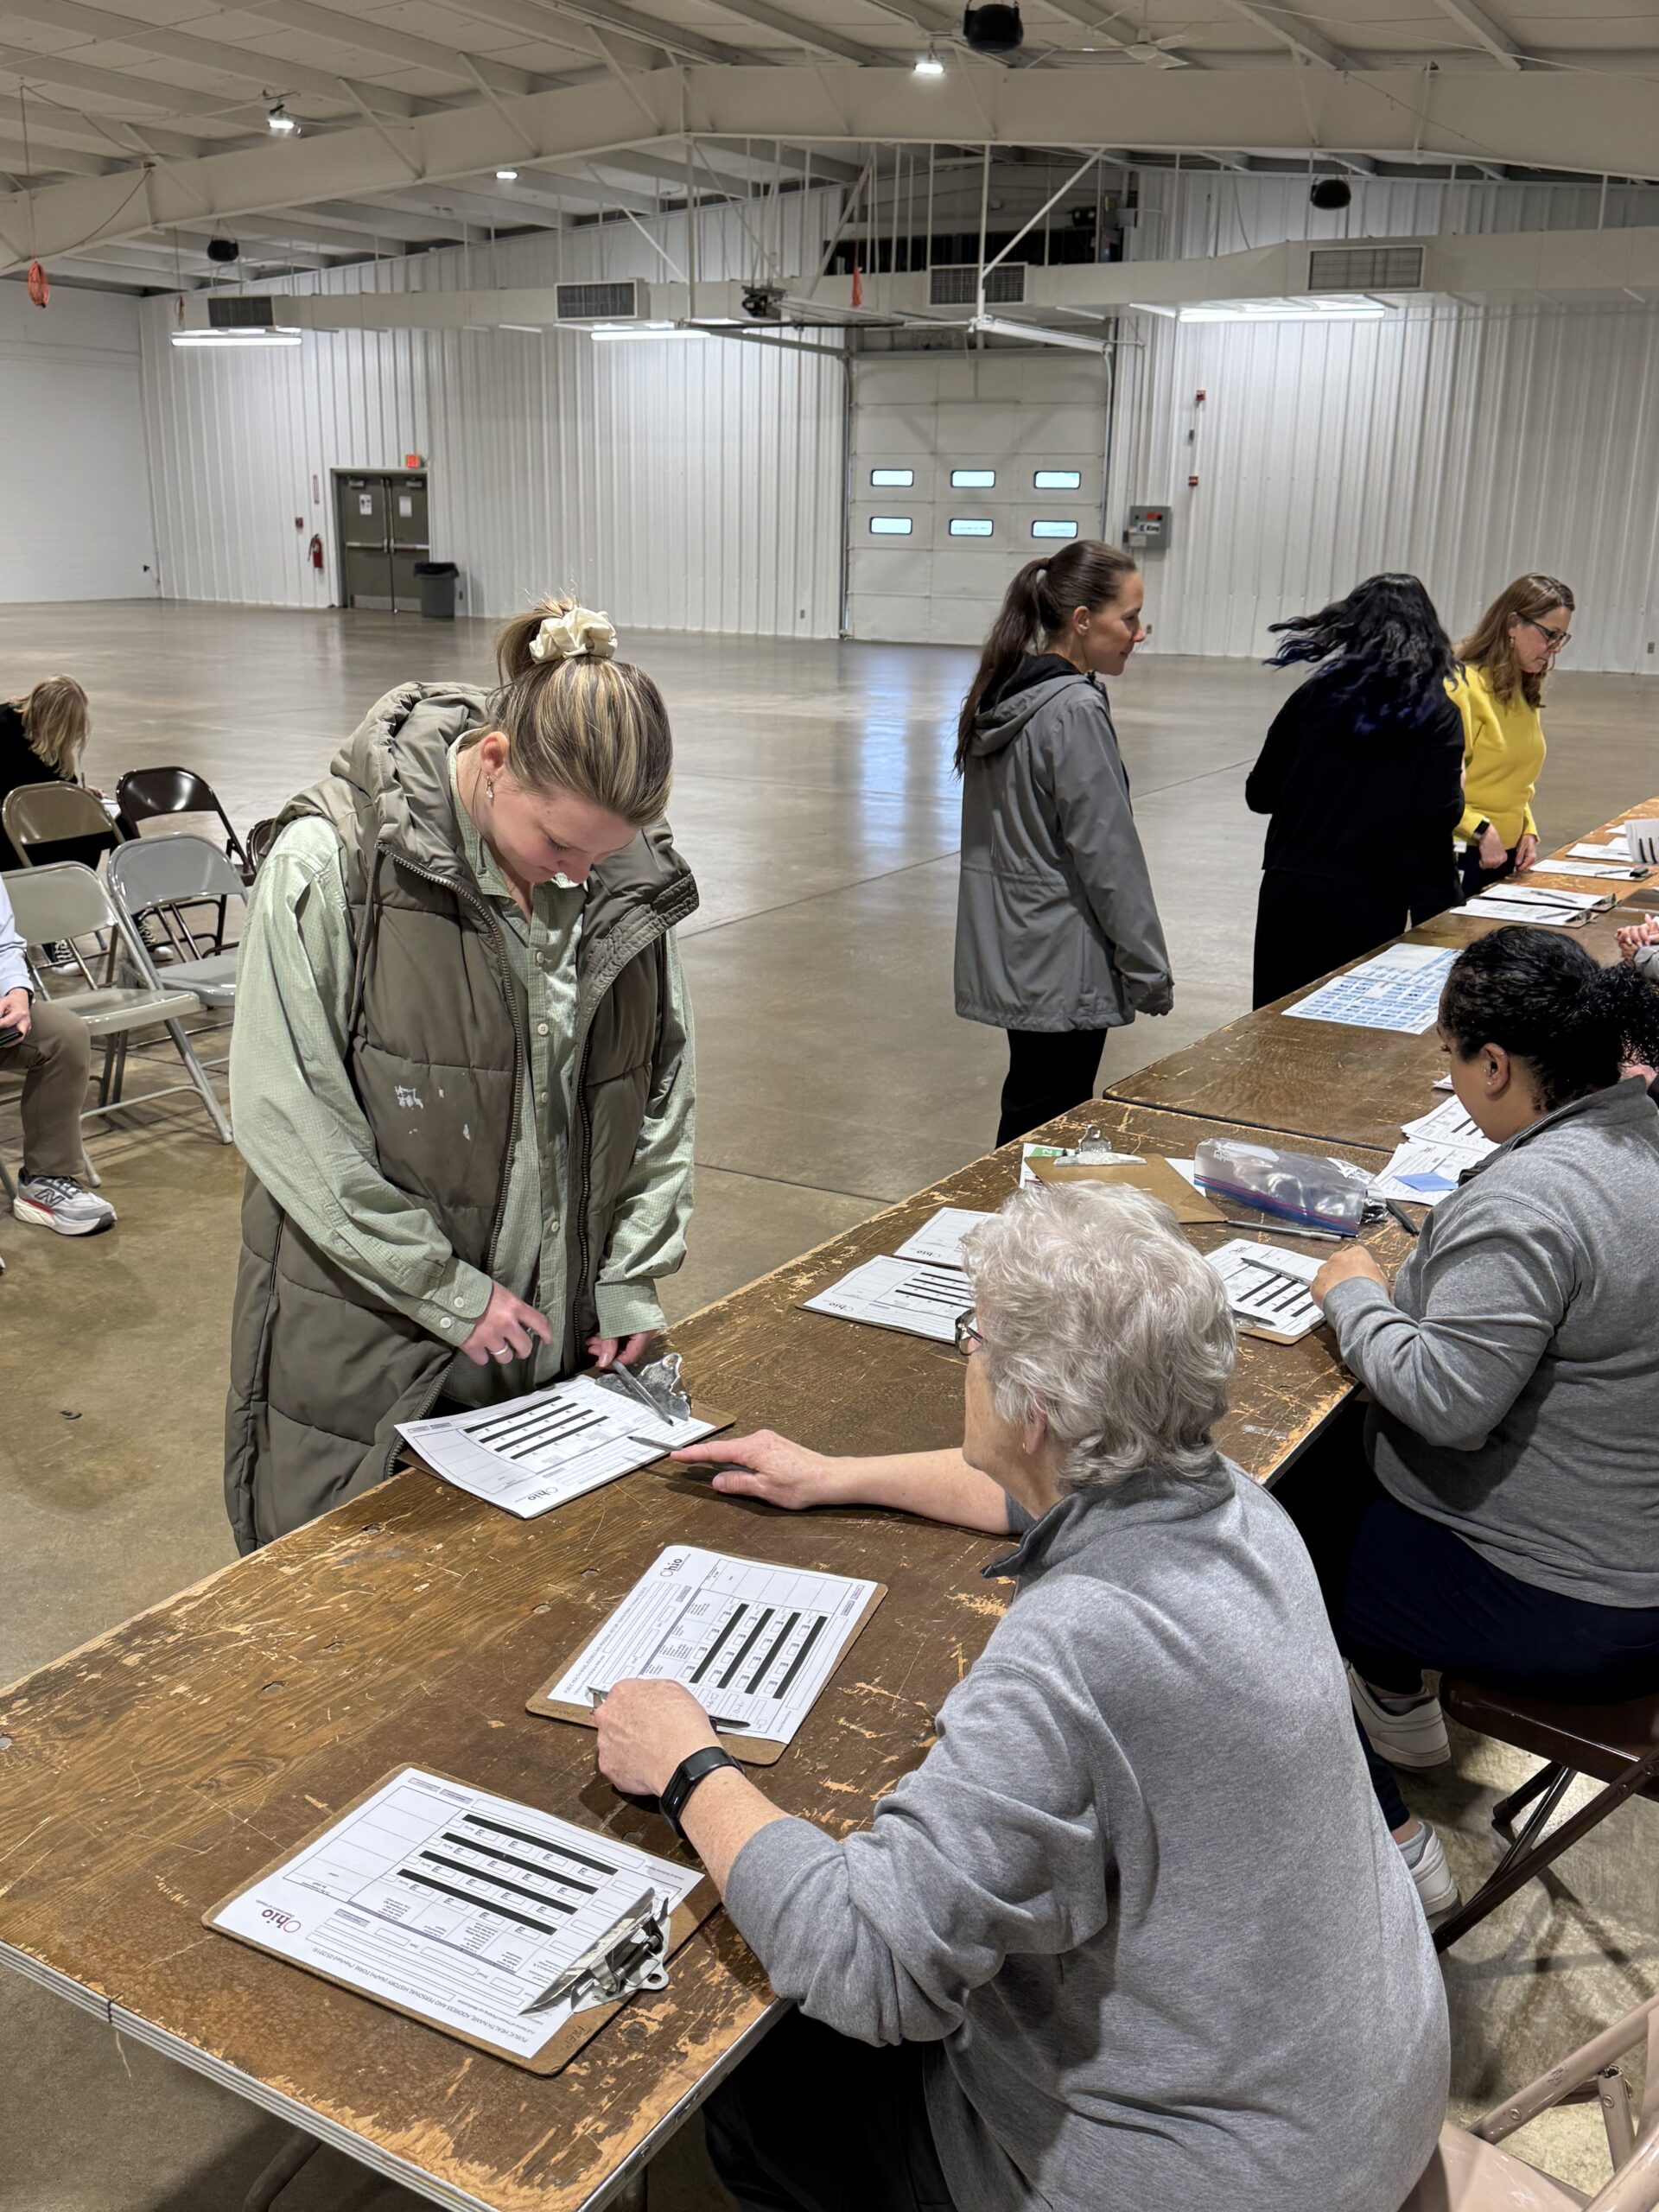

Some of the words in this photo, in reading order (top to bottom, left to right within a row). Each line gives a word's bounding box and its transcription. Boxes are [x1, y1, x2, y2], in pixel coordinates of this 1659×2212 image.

[528, 1486, 558, 1501] Ohio
[660, 1559, 683, 1577] Ohio
[262, 1909, 302, 1933] Ohio
[388, 1980, 409, 1991] HISTORY
[410, 1989, 435, 2002] PERSONAL
[447, 2005, 471, 2017] ADDRESS
[488, 2023, 509, 2034] HEALTH
